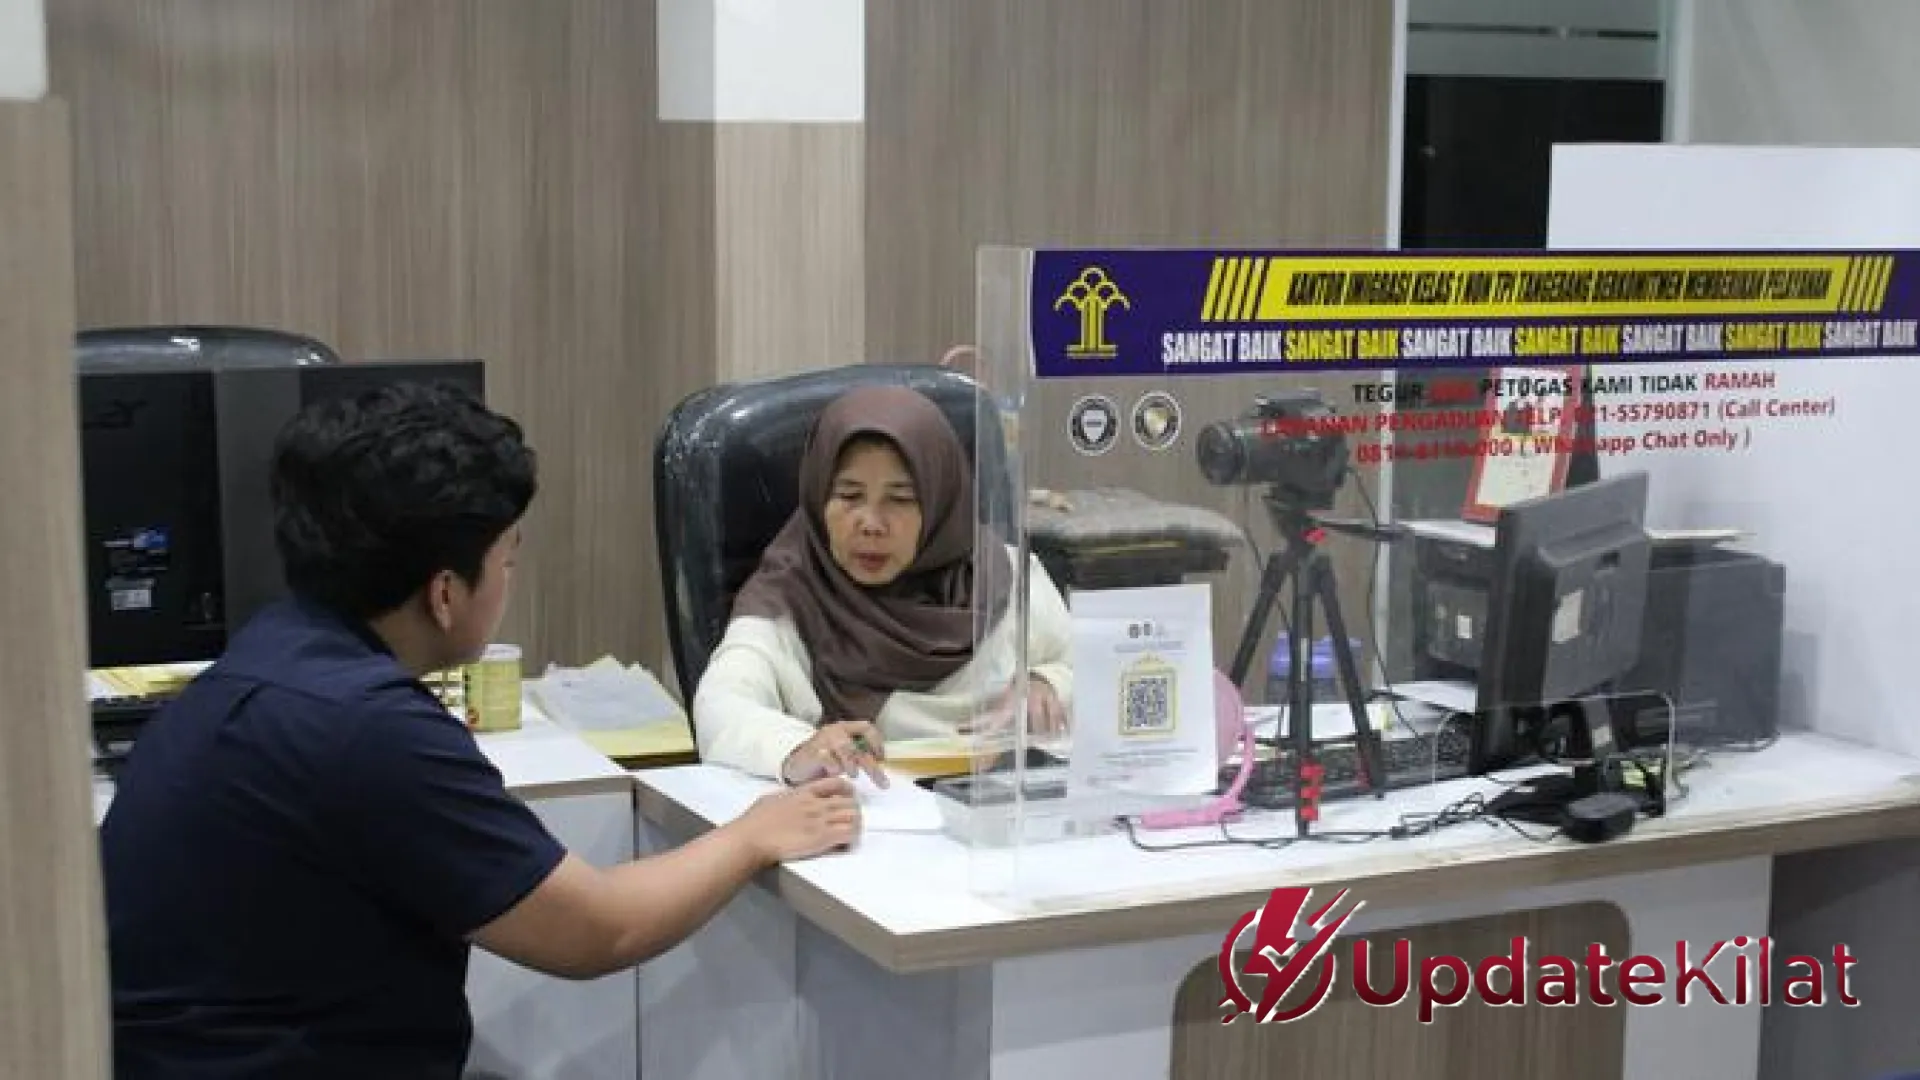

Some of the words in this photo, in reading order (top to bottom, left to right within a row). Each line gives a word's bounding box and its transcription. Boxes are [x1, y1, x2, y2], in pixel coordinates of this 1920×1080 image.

[1163, 331, 1235, 363] SANGAT
[1238, 331, 1281, 362] BAIK
[1286, 330, 1355, 361] SANGAT
[1358, 329, 1398, 359] BAIK
[1403, 328, 1469, 358] SANGAT
[1471, 327, 1513, 356] BAIK
[1515, 326, 1578, 354] SANGAT
[1581, 325, 1619, 354] BAIK
[1622, 324, 1684, 354] SANGAT
[1686, 322, 1723, 351] BAIK
[1725, 321, 1784, 350] SANGAT
[1787, 321, 1822, 348] BAIK
[1825, 320, 1880, 348] SANGAT
[1883, 319, 1917, 346] BAIK
[1639, 373, 1698, 394] TIDAK
[1704, 371, 1776, 389] RAMAH
[1717, 398, 1761, 422] (Call
[1766, 396, 1836, 418] Center)
[1643, 430, 1689, 449] Chat
[1694, 428, 1738, 450] Only
